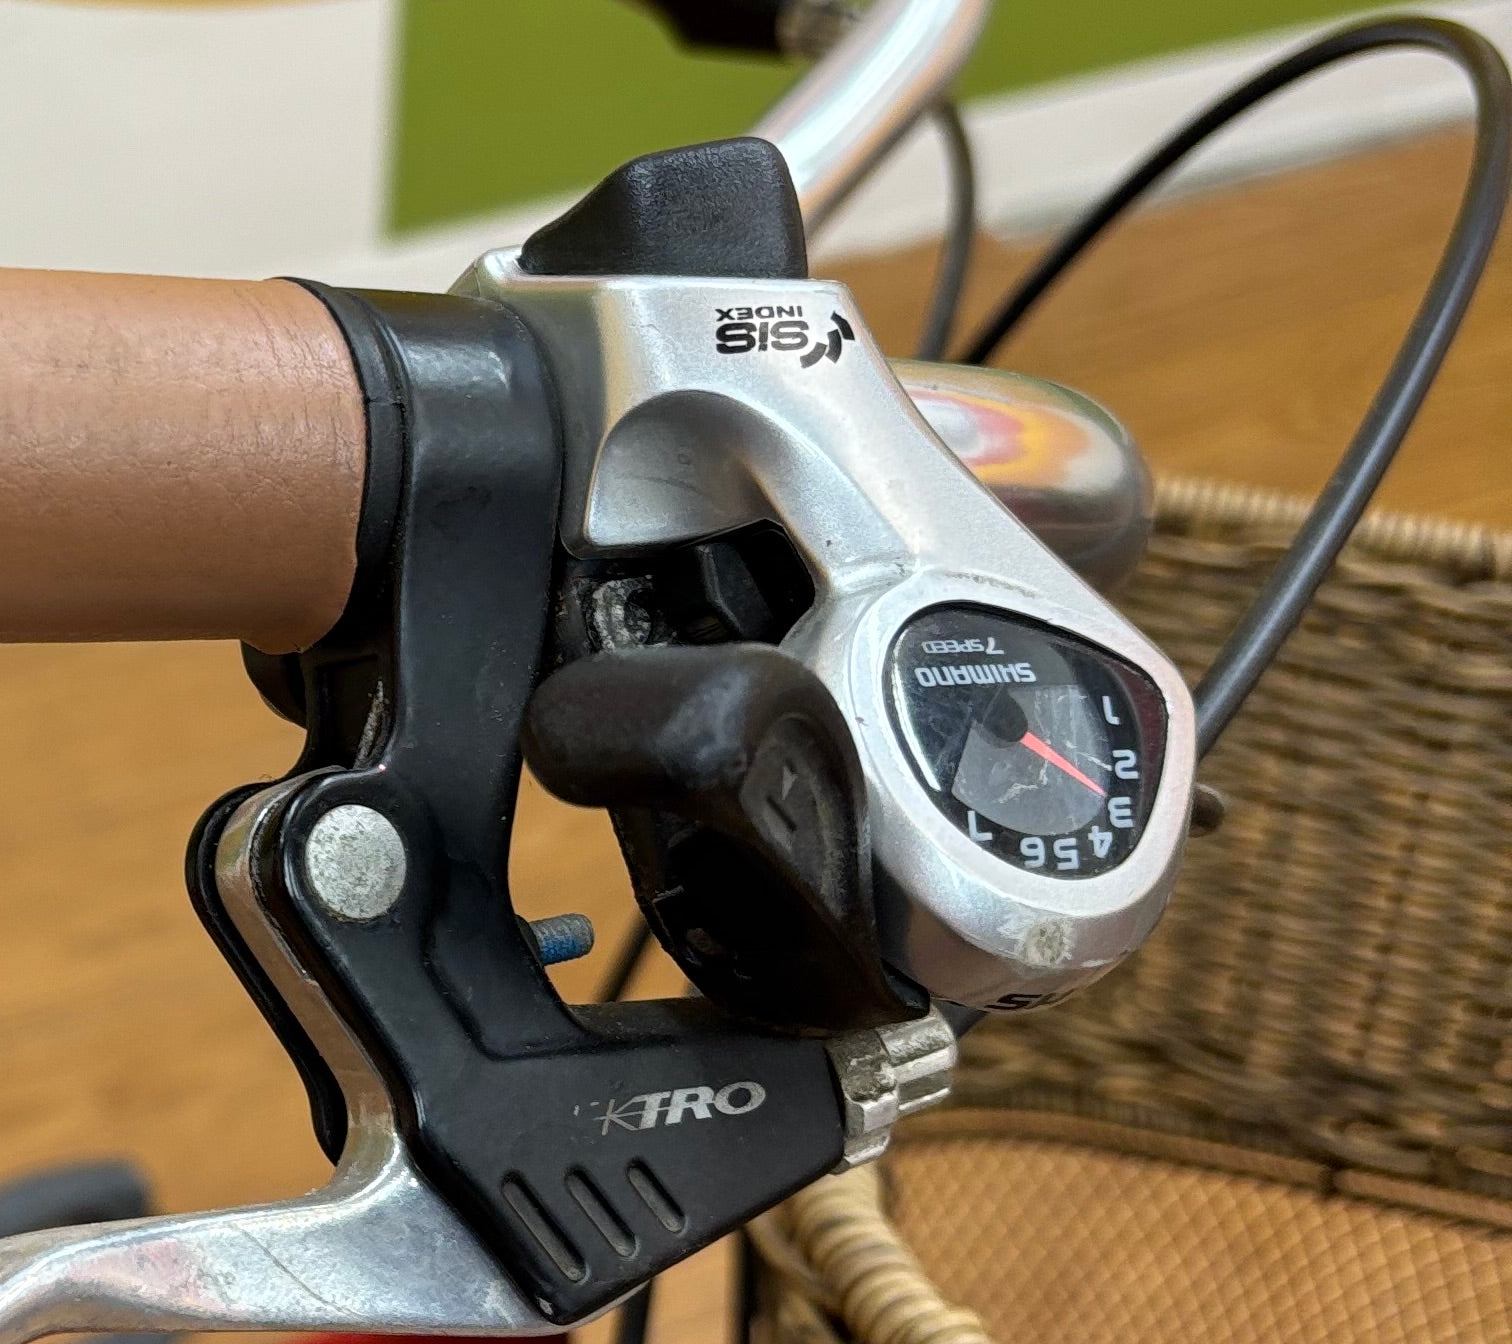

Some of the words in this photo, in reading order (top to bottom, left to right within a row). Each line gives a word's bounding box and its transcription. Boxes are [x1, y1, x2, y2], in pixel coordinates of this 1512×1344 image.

[715, 305, 803, 321] INDEX
[715, 320, 809, 355] SIS
[921, 638, 986, 654] SPEED
[914, 662, 1037, 688] SHIMANO
[1101, 695, 1121, 725] 1
[1112, 749, 1139, 780] 2
[967, 810, 993, 842] 7
[1107, 796, 1134, 829] 3
[1019, 836, 1046, 870] 6
[1052, 837, 1080, 870] 5
[1088, 825, 1113, 859] 4
[573, 1081, 767, 1136] KTRO
